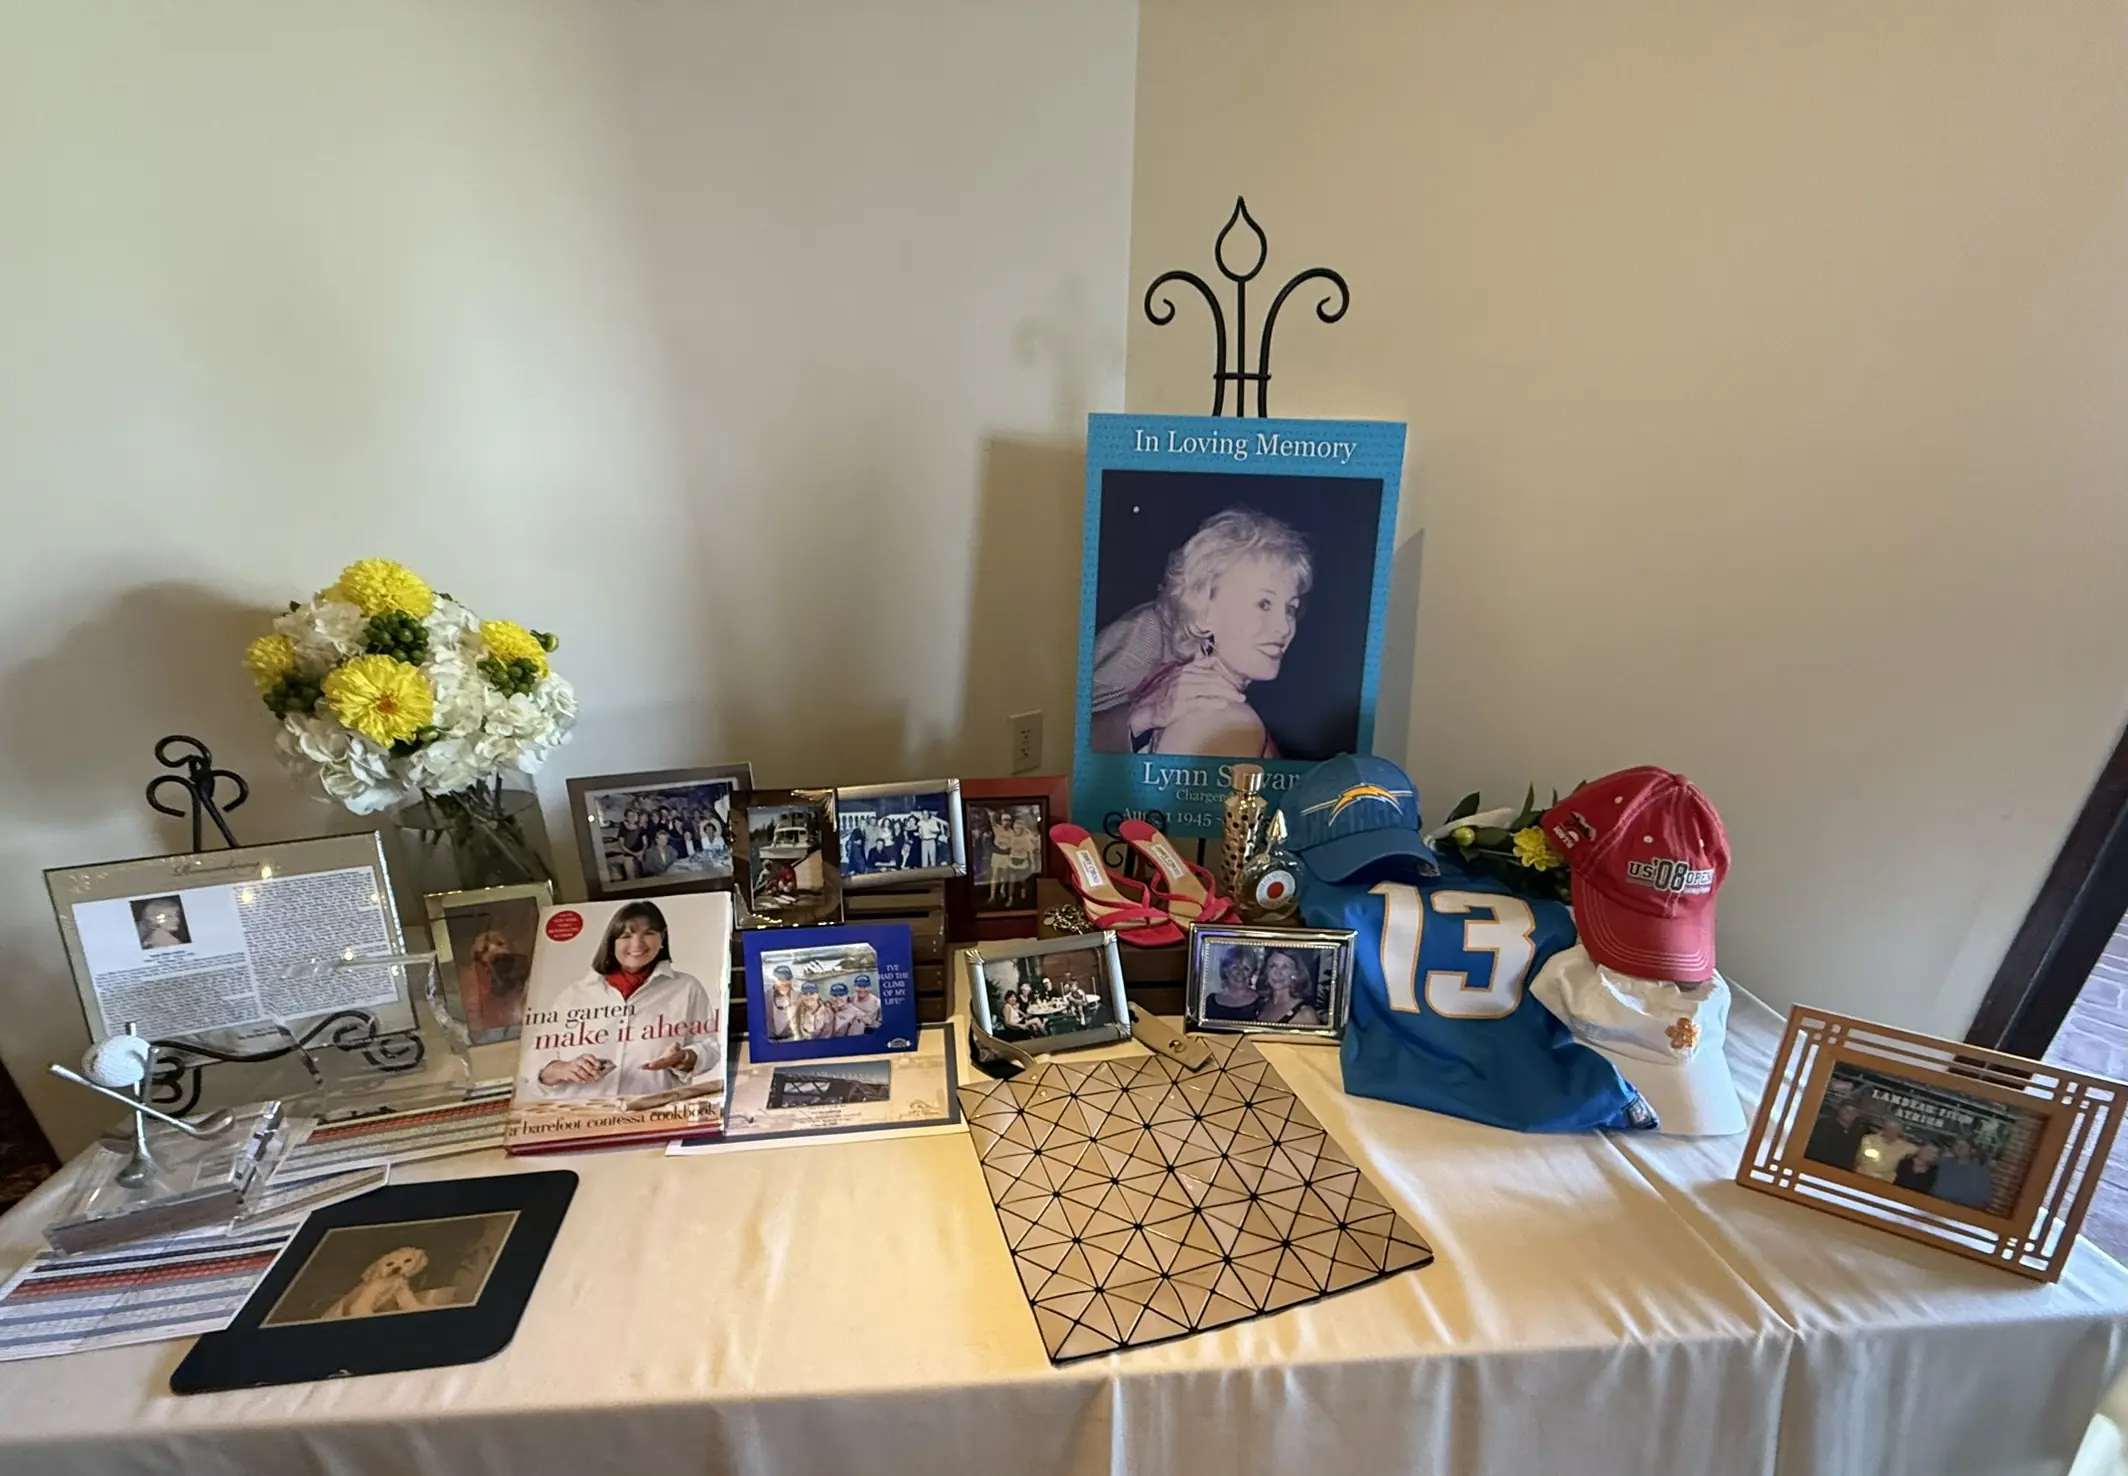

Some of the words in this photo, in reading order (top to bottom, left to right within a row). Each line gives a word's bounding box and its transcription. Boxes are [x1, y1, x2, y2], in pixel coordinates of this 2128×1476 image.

[1135, 429, 1160, 453] In
[1167, 430, 1249, 461] Loving
[1256, 432, 1358, 465] Memory
[1142, 761, 1209, 791] Lynn
[1178, 812, 1213, 828] 1945
[1628, 862, 1653, 878] US
[1369, 881, 1536, 1019] 13
[525, 1007, 559, 1026] ina
[565, 1002, 636, 1030] garten
[535, 1021, 609, 1050] make
[617, 1019, 632, 1043] it
[641, 1008, 720, 1041] ahead
[508, 1126, 518, 1137] a
[521, 1117, 581, 1136] barefoot
[586, 1114, 645, 1130] contessa
[649, 1101, 717, 1122] cookbook
